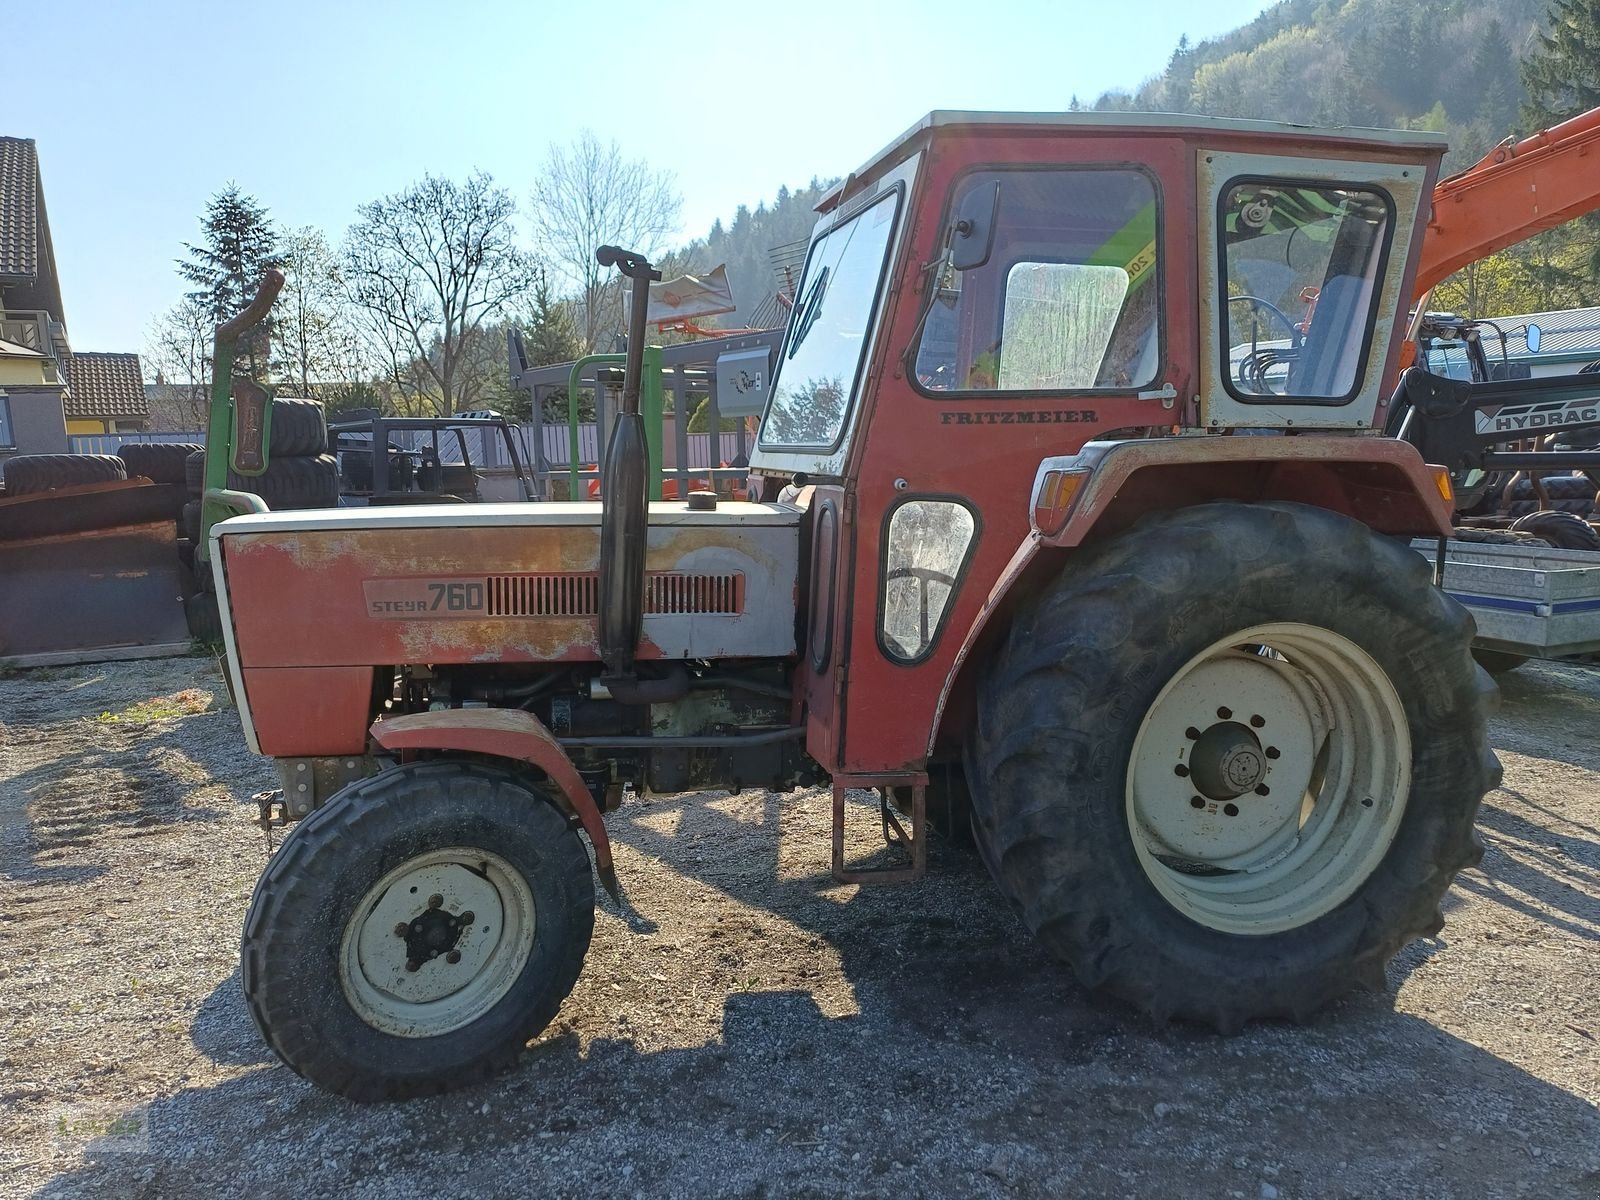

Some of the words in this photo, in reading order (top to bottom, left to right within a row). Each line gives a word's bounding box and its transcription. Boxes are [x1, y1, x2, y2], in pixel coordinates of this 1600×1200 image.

[940, 410, 1099, 425] FRITZMEIER
[1495, 408, 1597, 431] HYDRAC
[372, 600, 427, 613] STEYR
[427, 583, 484, 611] 760
